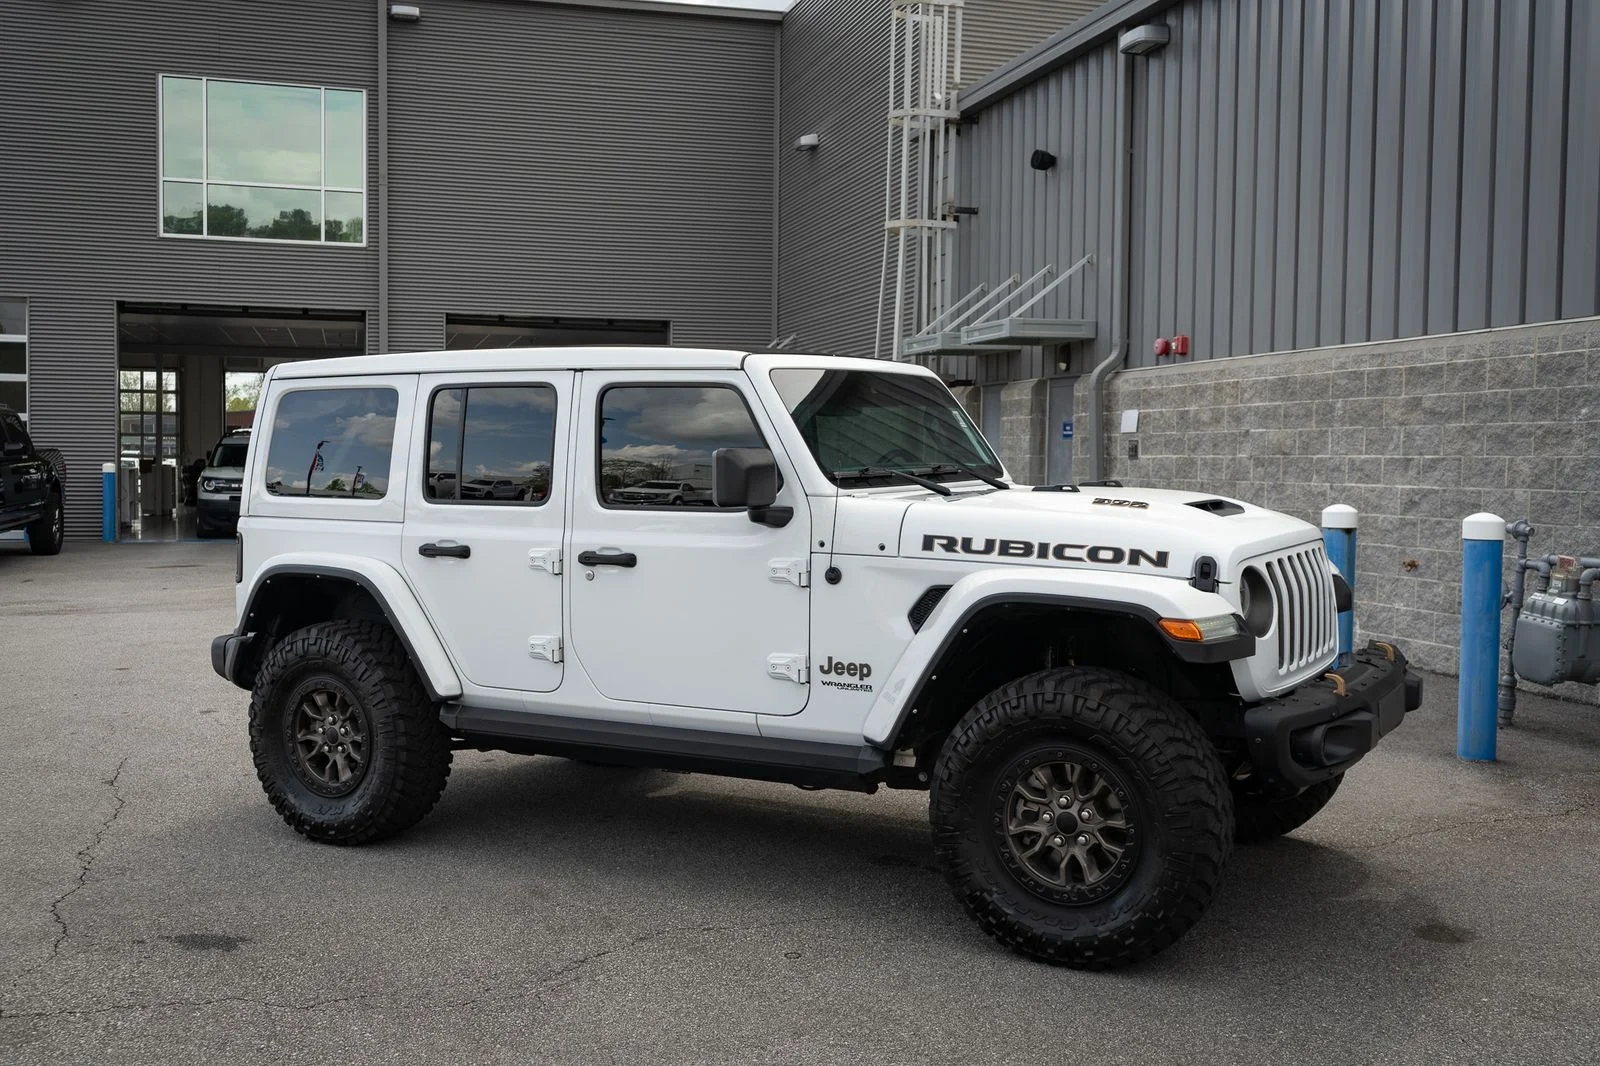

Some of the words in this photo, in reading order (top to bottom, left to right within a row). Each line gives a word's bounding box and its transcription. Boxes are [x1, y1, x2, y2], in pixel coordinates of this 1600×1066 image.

[921, 534, 1170, 568] RUBICON
[819, 655, 872, 681] Jeep
[821, 680, 872, 690] WRANGLER
